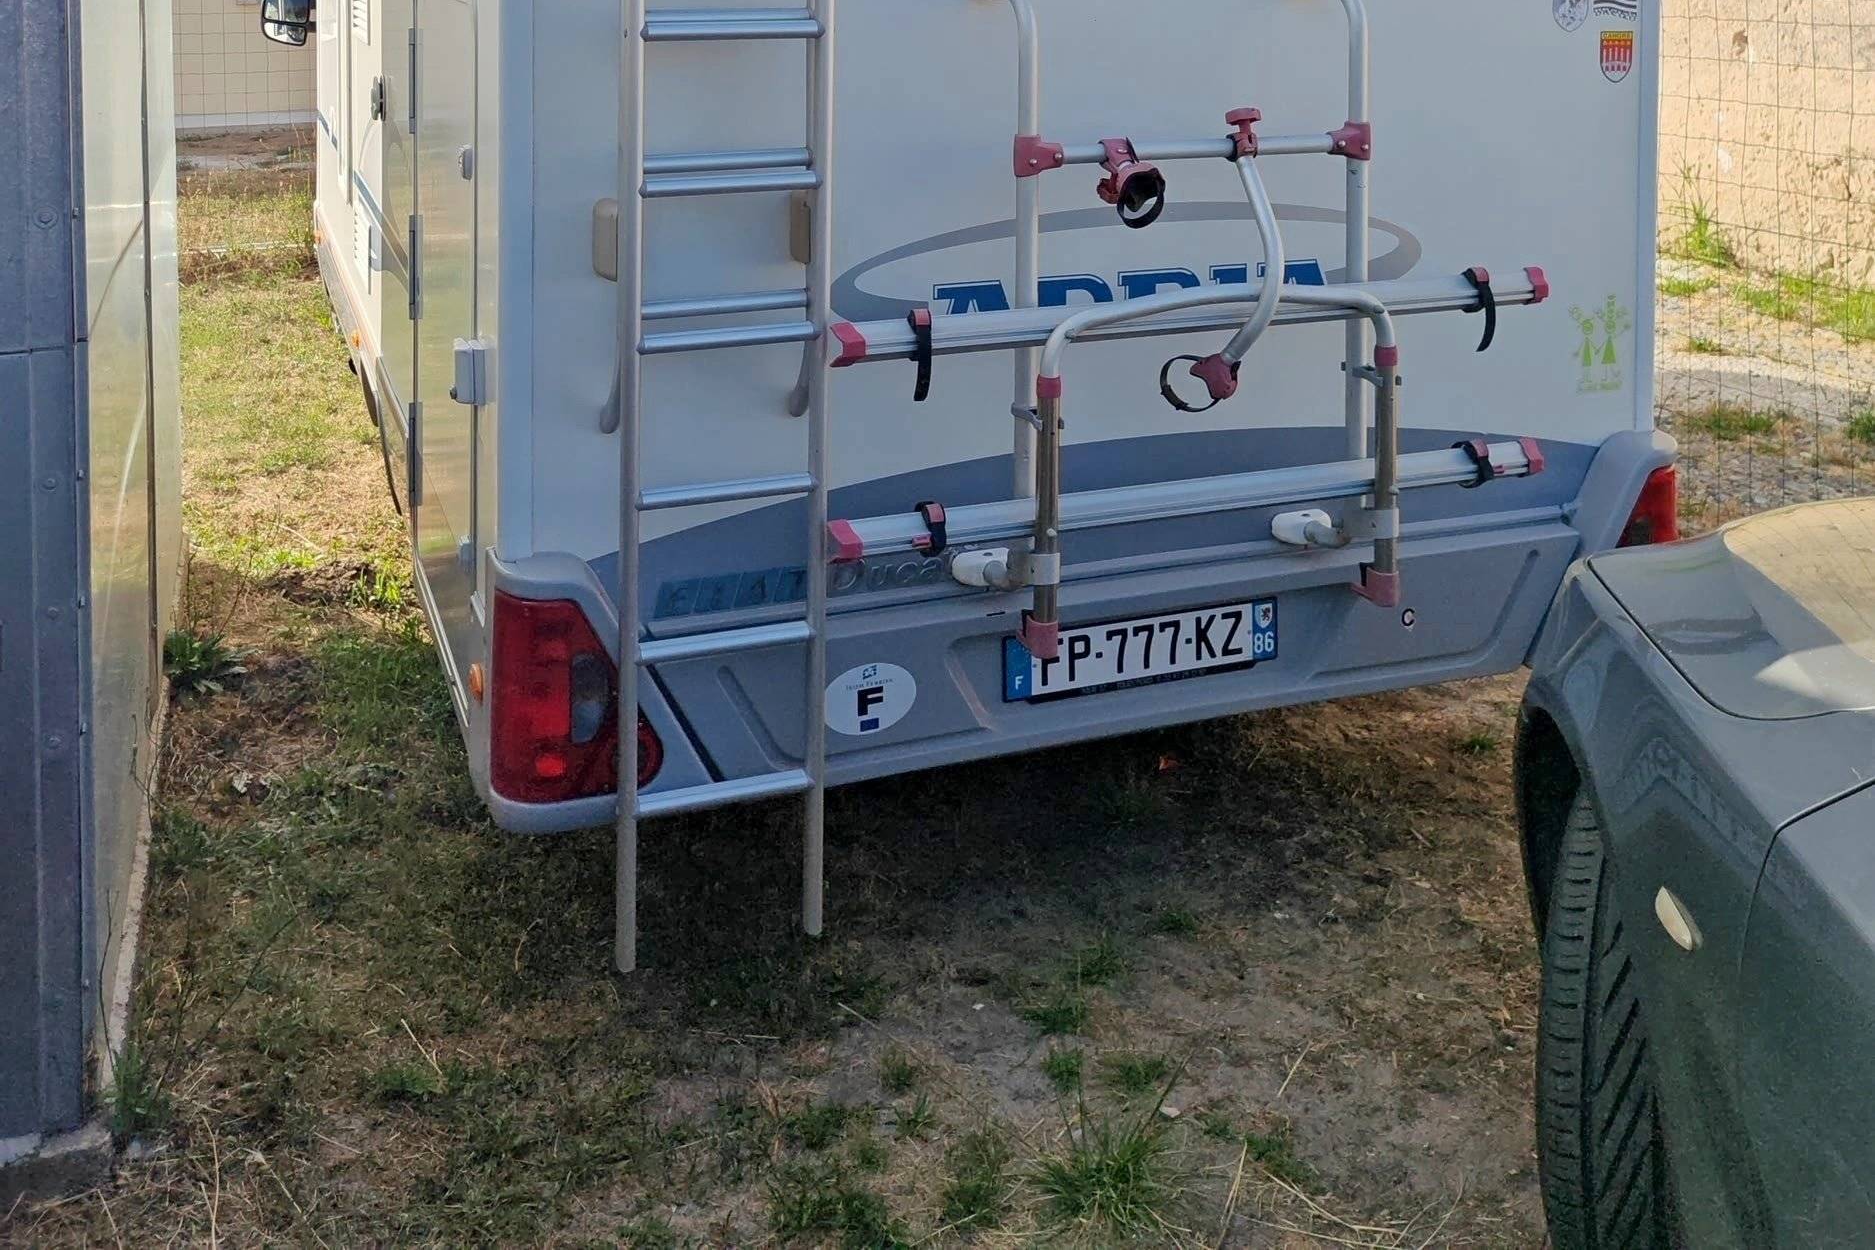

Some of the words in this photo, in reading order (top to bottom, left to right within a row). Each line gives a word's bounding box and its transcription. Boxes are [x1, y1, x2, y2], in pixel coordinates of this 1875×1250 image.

[1253, 631, 1274, 654] 86
[1014, 675, 1023, 690] F
[857, 685, 884, 717] F
